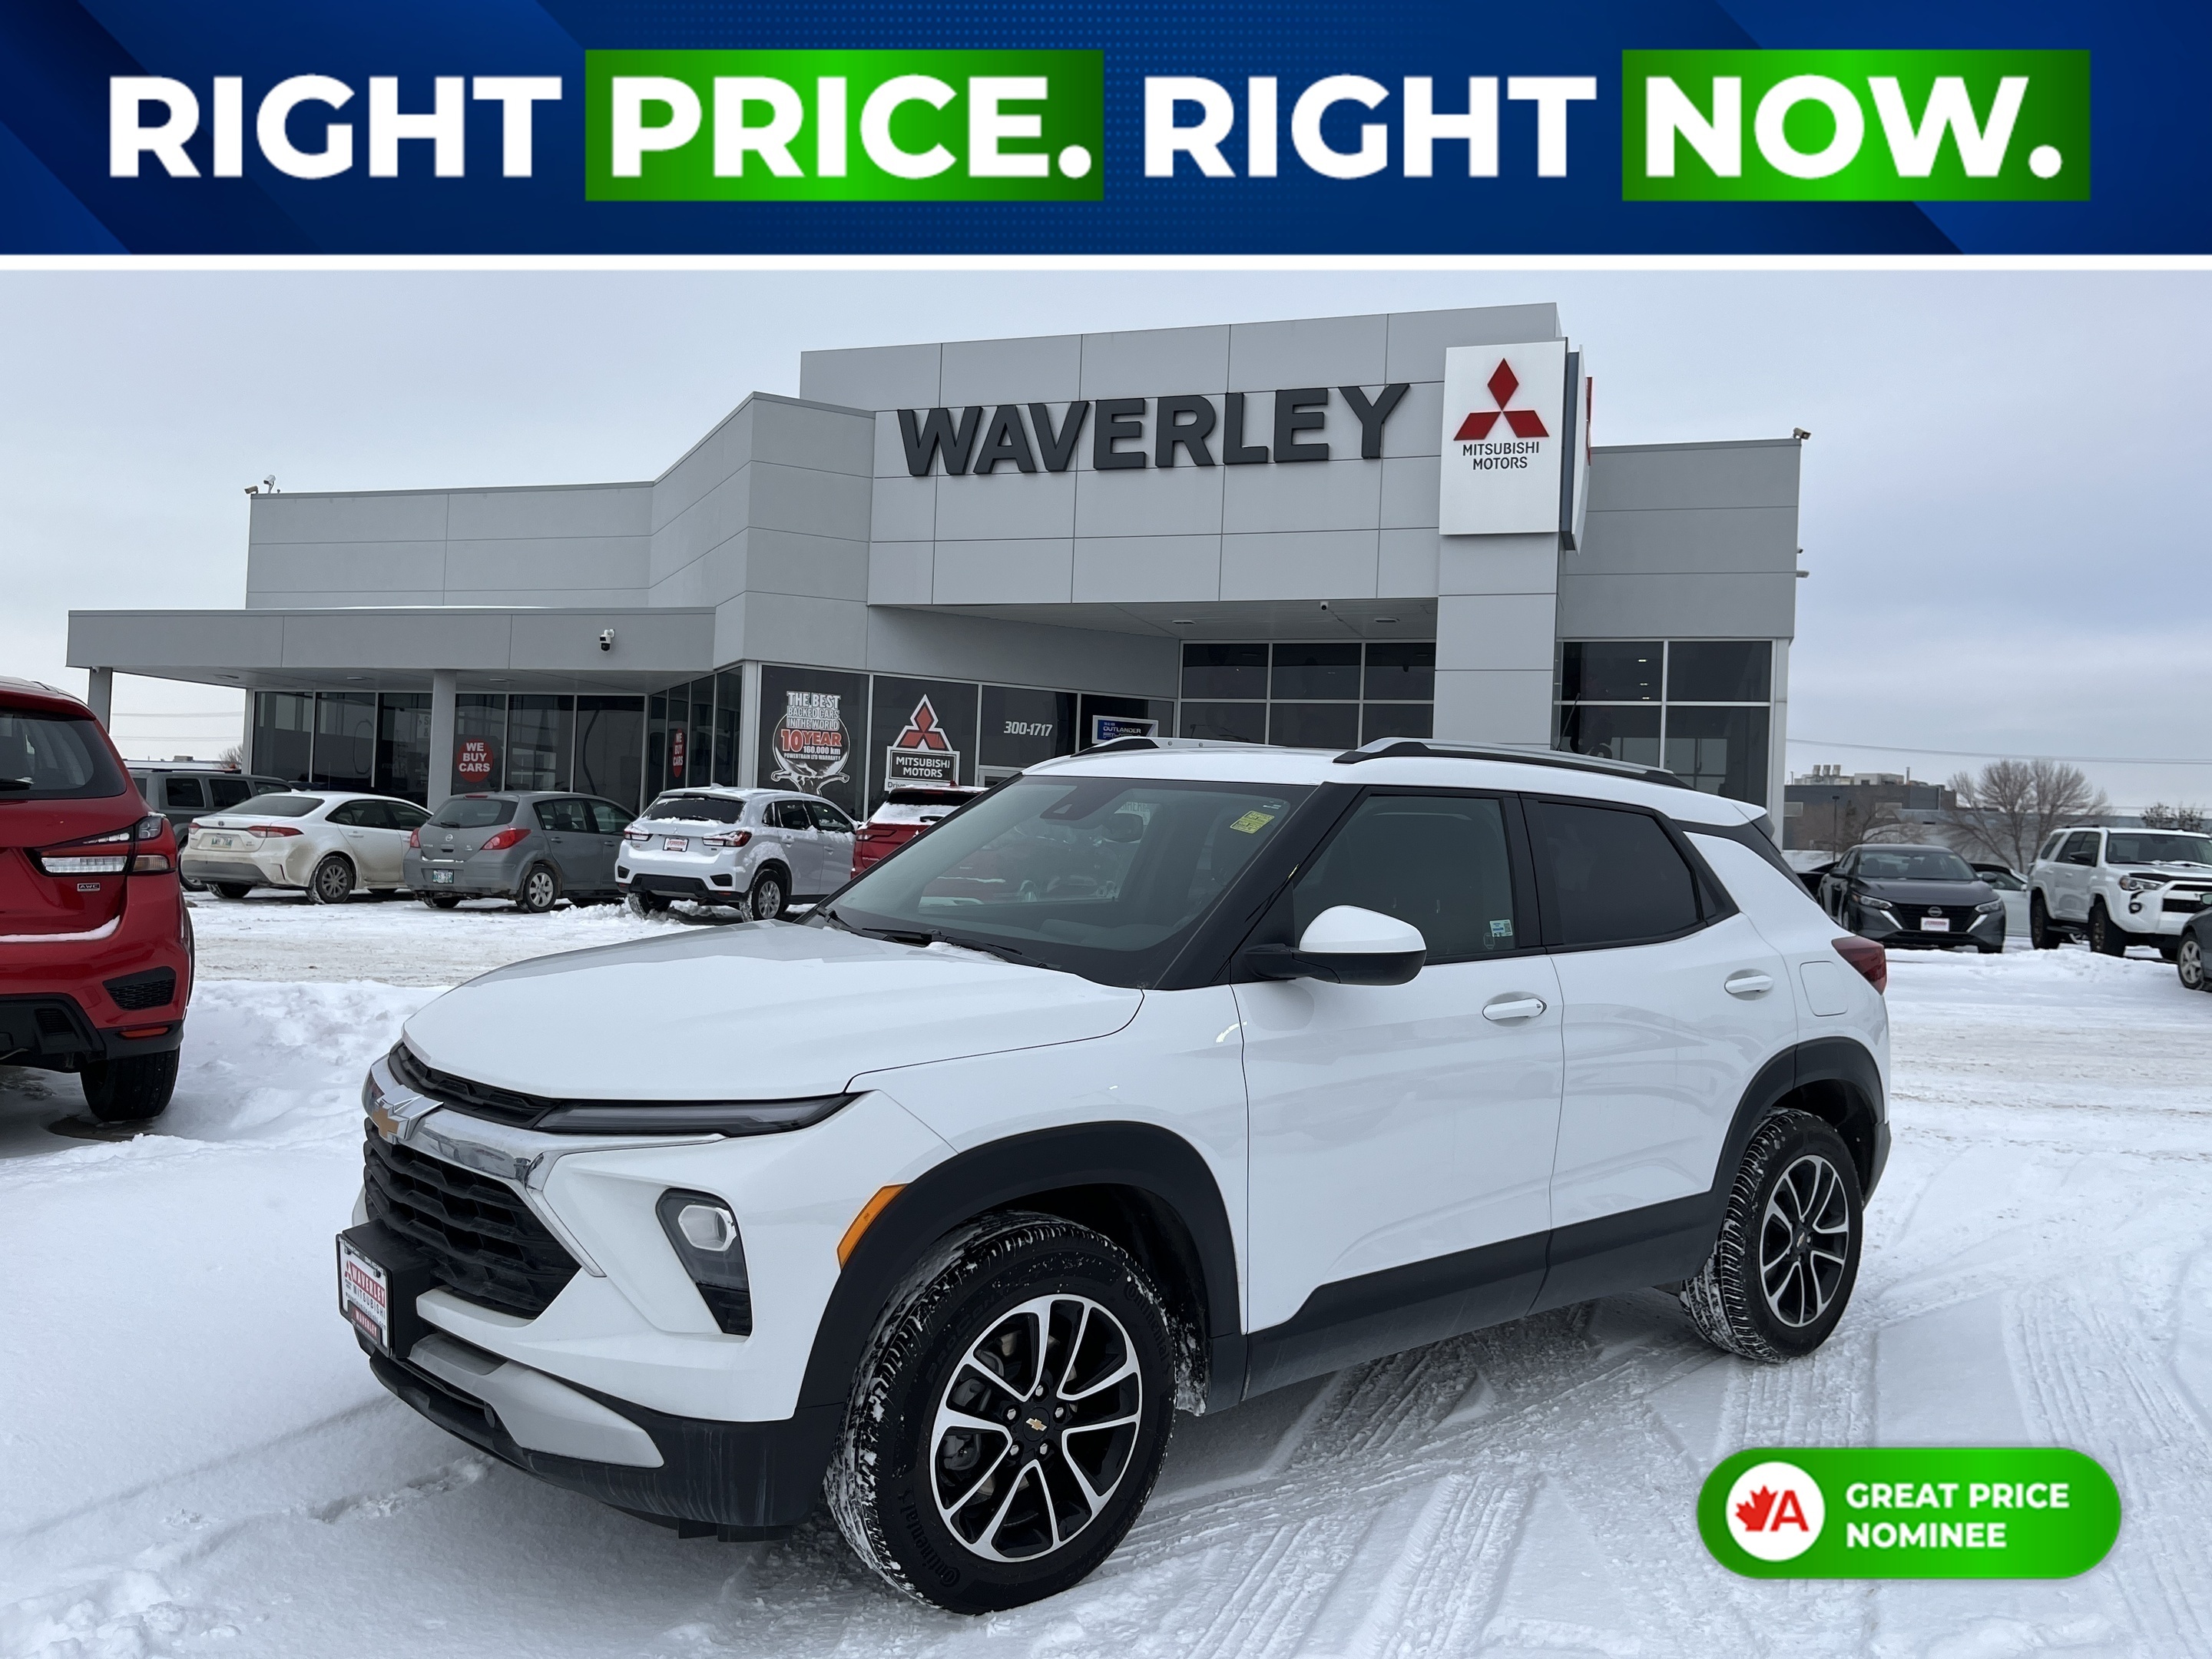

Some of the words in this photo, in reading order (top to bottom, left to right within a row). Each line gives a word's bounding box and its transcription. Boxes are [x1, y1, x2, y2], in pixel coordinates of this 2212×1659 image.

[897, 383, 1409, 476] WAVERLEY
[1462, 442, 1539, 455] MITSUBISHI
[1473, 457, 1528, 470] MOTORS
[787, 692, 810, 707] THE
[812, 694, 840, 710] BEST
[788, 707, 818, 717] BACKED
[819, 710, 839, 719] CARS
[788, 718, 794, 727] IN
[794, 719, 811, 728] THE
[812, 720, 839, 730] WORLD
[1004, 721, 1052, 737] 300-1717
[1103, 726, 1141, 734] OUTLANDER
[676, 733, 682, 743] WE
[781, 729, 803, 752] 10
[803, 730, 842, 747] YEAR
[466, 743, 484, 751] WE
[674, 744, 683, 754] BUY
[463, 753, 487, 761] BUY
[673, 756, 683, 766] CARS
[896, 757, 950, 768] MITSUBISHI
[459, 763, 490, 772] CARS
[903, 767, 942, 777] MOTORS
[352, 1264, 386, 1306] WAVERLEY
[353, 1285, 386, 1320] MITSUBISHI
